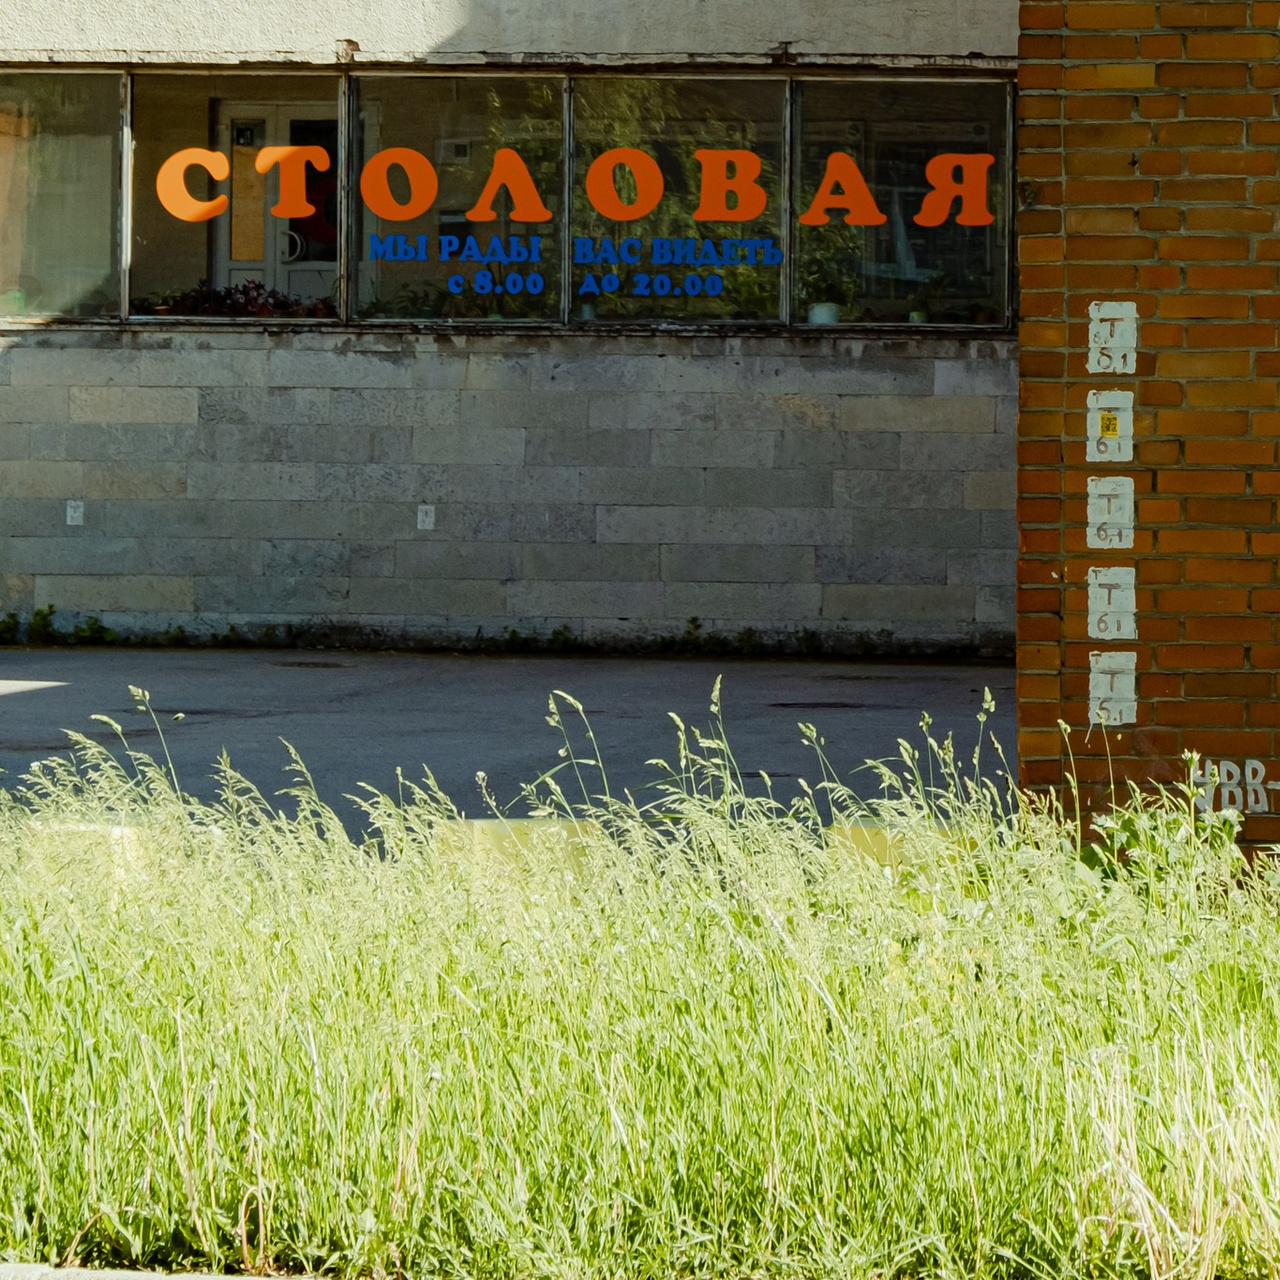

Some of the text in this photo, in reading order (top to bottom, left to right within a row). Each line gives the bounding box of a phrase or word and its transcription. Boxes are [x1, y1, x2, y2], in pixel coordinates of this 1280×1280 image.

[156, 146, 996, 228] СТОЛОВАЯ
[369, 233, 784, 269] МЫ РАДЫ ВАС ВИДЕТЬ
[473, 269, 545, 295] 8.00
[631, 272, 724, 297] 20.00
